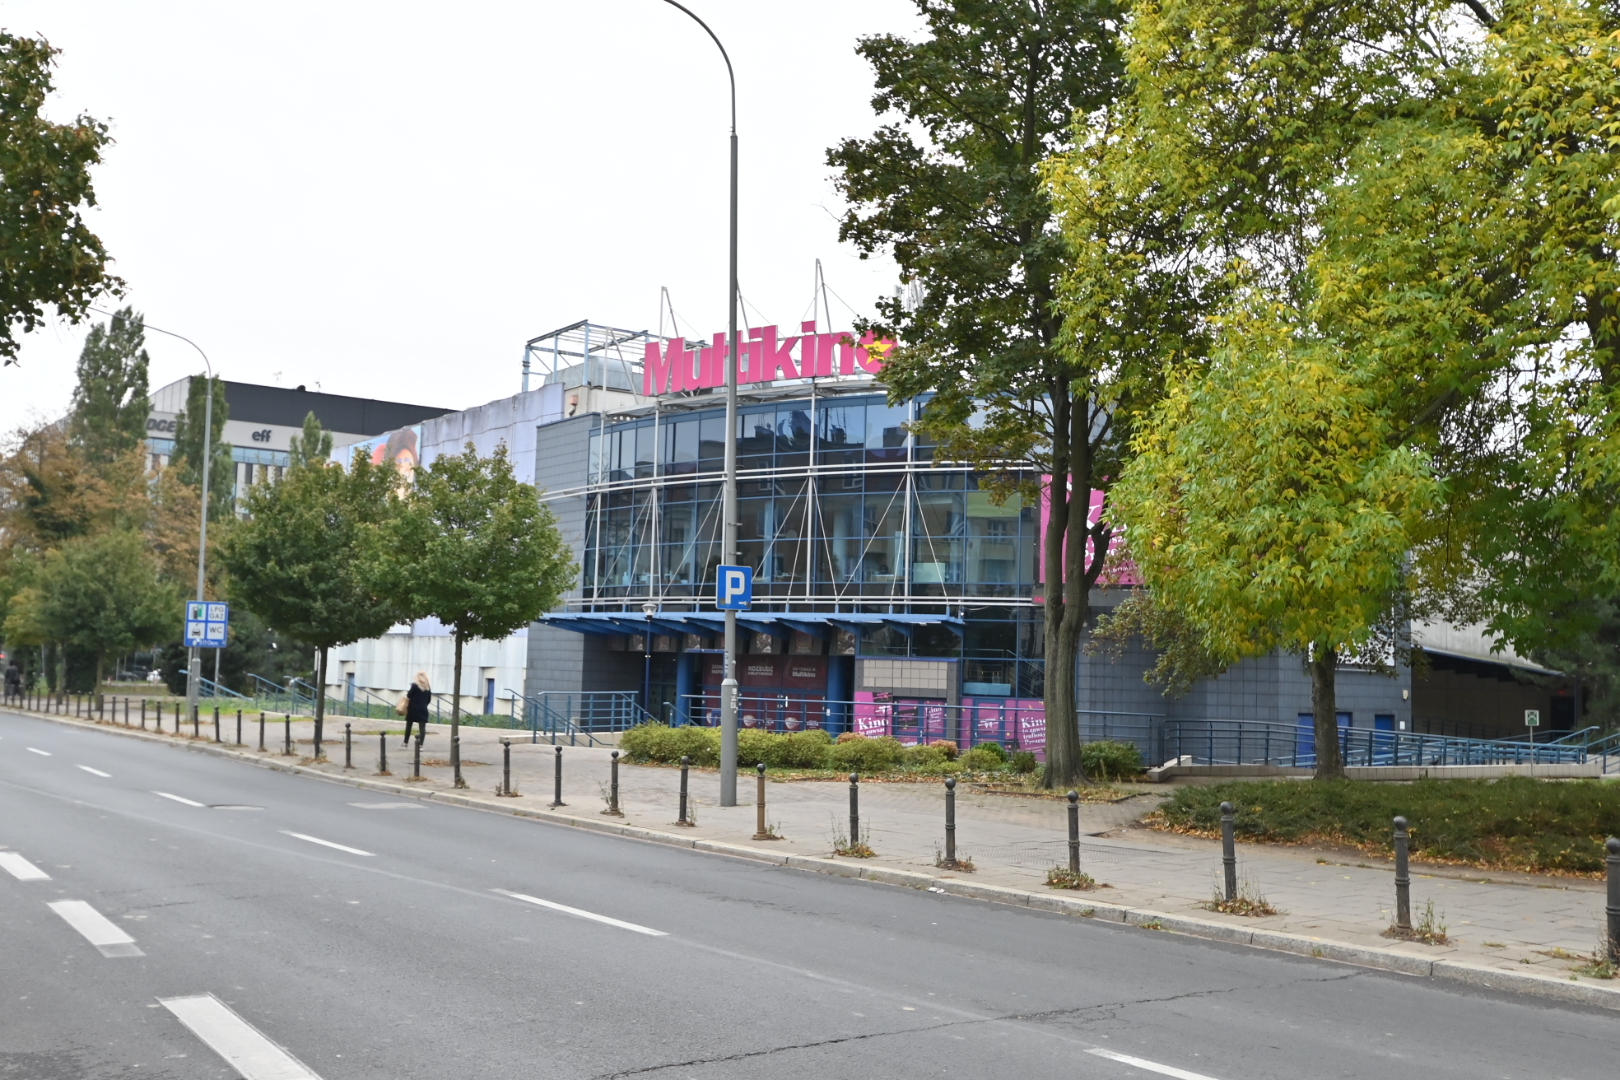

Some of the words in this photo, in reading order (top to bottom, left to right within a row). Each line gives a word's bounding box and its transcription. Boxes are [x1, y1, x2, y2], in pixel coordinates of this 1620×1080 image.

[643, 320, 899, 396] Multikino
[251, 429, 272, 442] eff
[725, 570, 745, 604] P
[209, 626, 223, 634] WC
[857, 717, 889, 730] Kino
